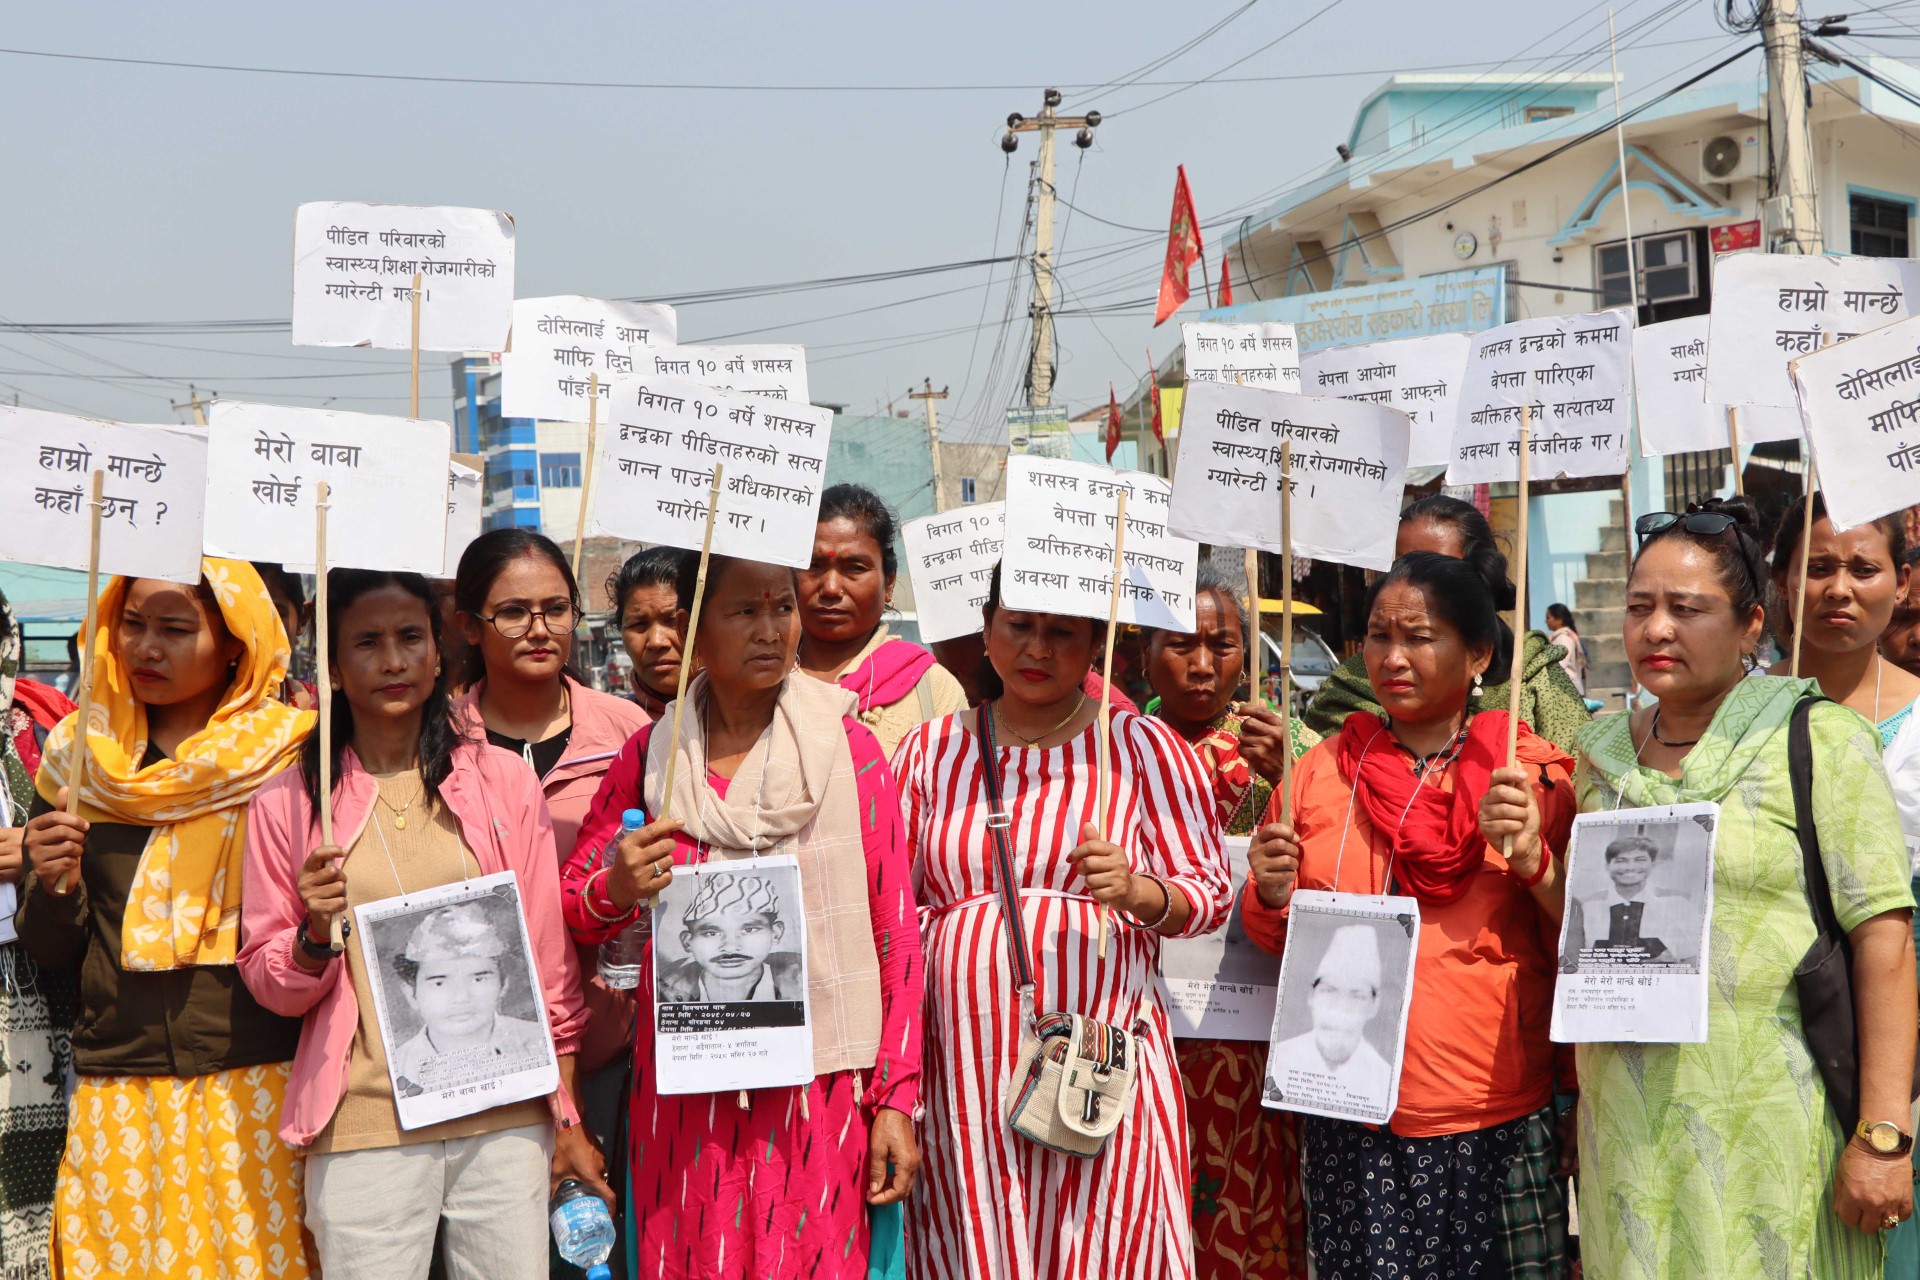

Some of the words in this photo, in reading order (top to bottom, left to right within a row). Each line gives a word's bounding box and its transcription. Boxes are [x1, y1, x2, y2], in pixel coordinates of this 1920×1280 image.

[327, 225, 369, 246] पीडित
[379, 229, 446, 248] परिवारको
[325, 280, 383, 301] ग्यारेन्टी
[1779, 281, 1829, 313] हाम्रो
[1843, 284, 1903, 315] मान्छे
[537, 314, 605, 339] दोसिलाई
[616, 326, 650, 344] आम
[1775, 324, 1822, 354] कहाँ
[1197, 333, 1218, 352] विगत
[1222, 338, 1234, 354] १०
[1261, 337, 1292, 352] शसस्त्र
[1480, 339, 1513, 360] शसस्त्र
[1519, 328, 1566, 353] द्वन्द्वको
[1574, 326, 1620, 346] क्रममा
[1670, 338, 1705, 359] साक्षी
[553, 346, 595, 367] माफि
[655, 356, 690, 375] विगत
[697, 360, 716, 376] १०
[751, 359, 793, 373] शसस्त्र
[1357, 362, 1396, 381] आयोग
[1535, 363, 1595, 386] पारिएका
[637, 385, 685, 415] विगत
[693, 400, 718, 420] १०
[764, 414, 816, 438] शसस्त्र
[1553, 398, 1615, 419] सत्यतथ्य
[1217, 409, 1261, 433] पीडित
[1271, 419, 1340, 444] परिवारको
[254, 430, 295, 463] मेरो
[311, 443, 362, 468] बाबा
[619, 423, 673, 447] द्वन्द्वका
[682, 430, 779, 465] पीडितहरुको
[788, 453, 823, 474] सत्य
[1459, 442, 1500, 461] अवस्था
[1591, 434, 1612, 451] गर
[39, 442, 92, 473] हाम्रो
[108, 453, 166, 483] मान्छे
[252, 473, 302, 507] खोई
[618, 458, 662, 480] जान्न
[727, 474, 814, 507] अधिकारको
[1028, 471, 1079, 492] शसस्त्र
[1208, 468, 1267, 492] ग्यारेन्टी
[35, 484, 84, 514] कहाँ
[156, 502, 168, 525] ?
[728, 512, 752, 531] गर
[926, 521, 962, 539] विगत
[970, 517, 989, 531] १०
[922, 548, 962, 568] द्वन्द्वका
[1123, 550, 1184, 576] सत्यतथ्य
[930, 574, 962, 591] जान्न
[1013, 569, 1070, 590] अवस्था
[1162, 590, 1181, 609] गर
[1188, 981, 1200, 990] मेरो
[1584, 976, 1597, 985] मेरो
[1600, 976, 1613, 985] मेरो
[1616, 976, 1634, 986] मान्छे
[1637, 975, 1652, 986] खोई
